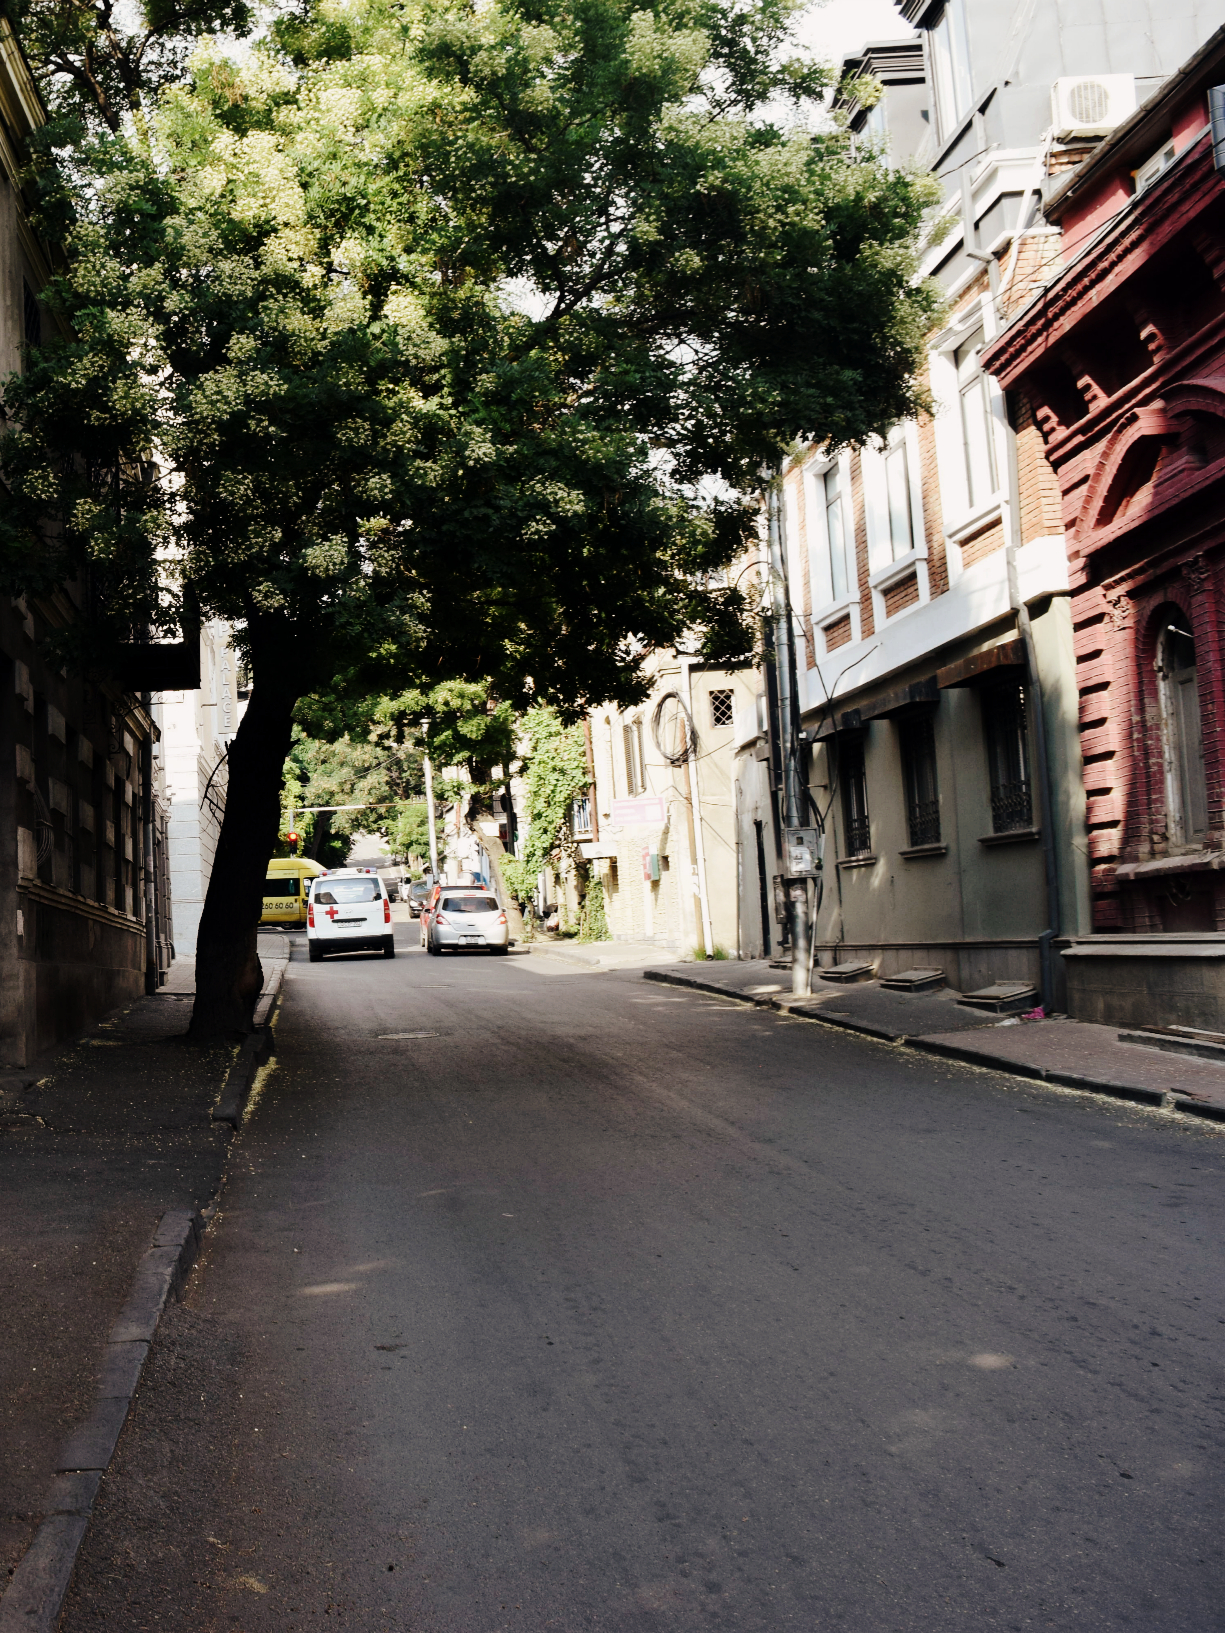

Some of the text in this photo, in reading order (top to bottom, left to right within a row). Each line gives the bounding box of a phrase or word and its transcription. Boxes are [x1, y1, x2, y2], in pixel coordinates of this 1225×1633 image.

[220, 646, 233, 728] PALACE
[274, 902, 284, 910] 60
[284, 902, 294, 910] 60
